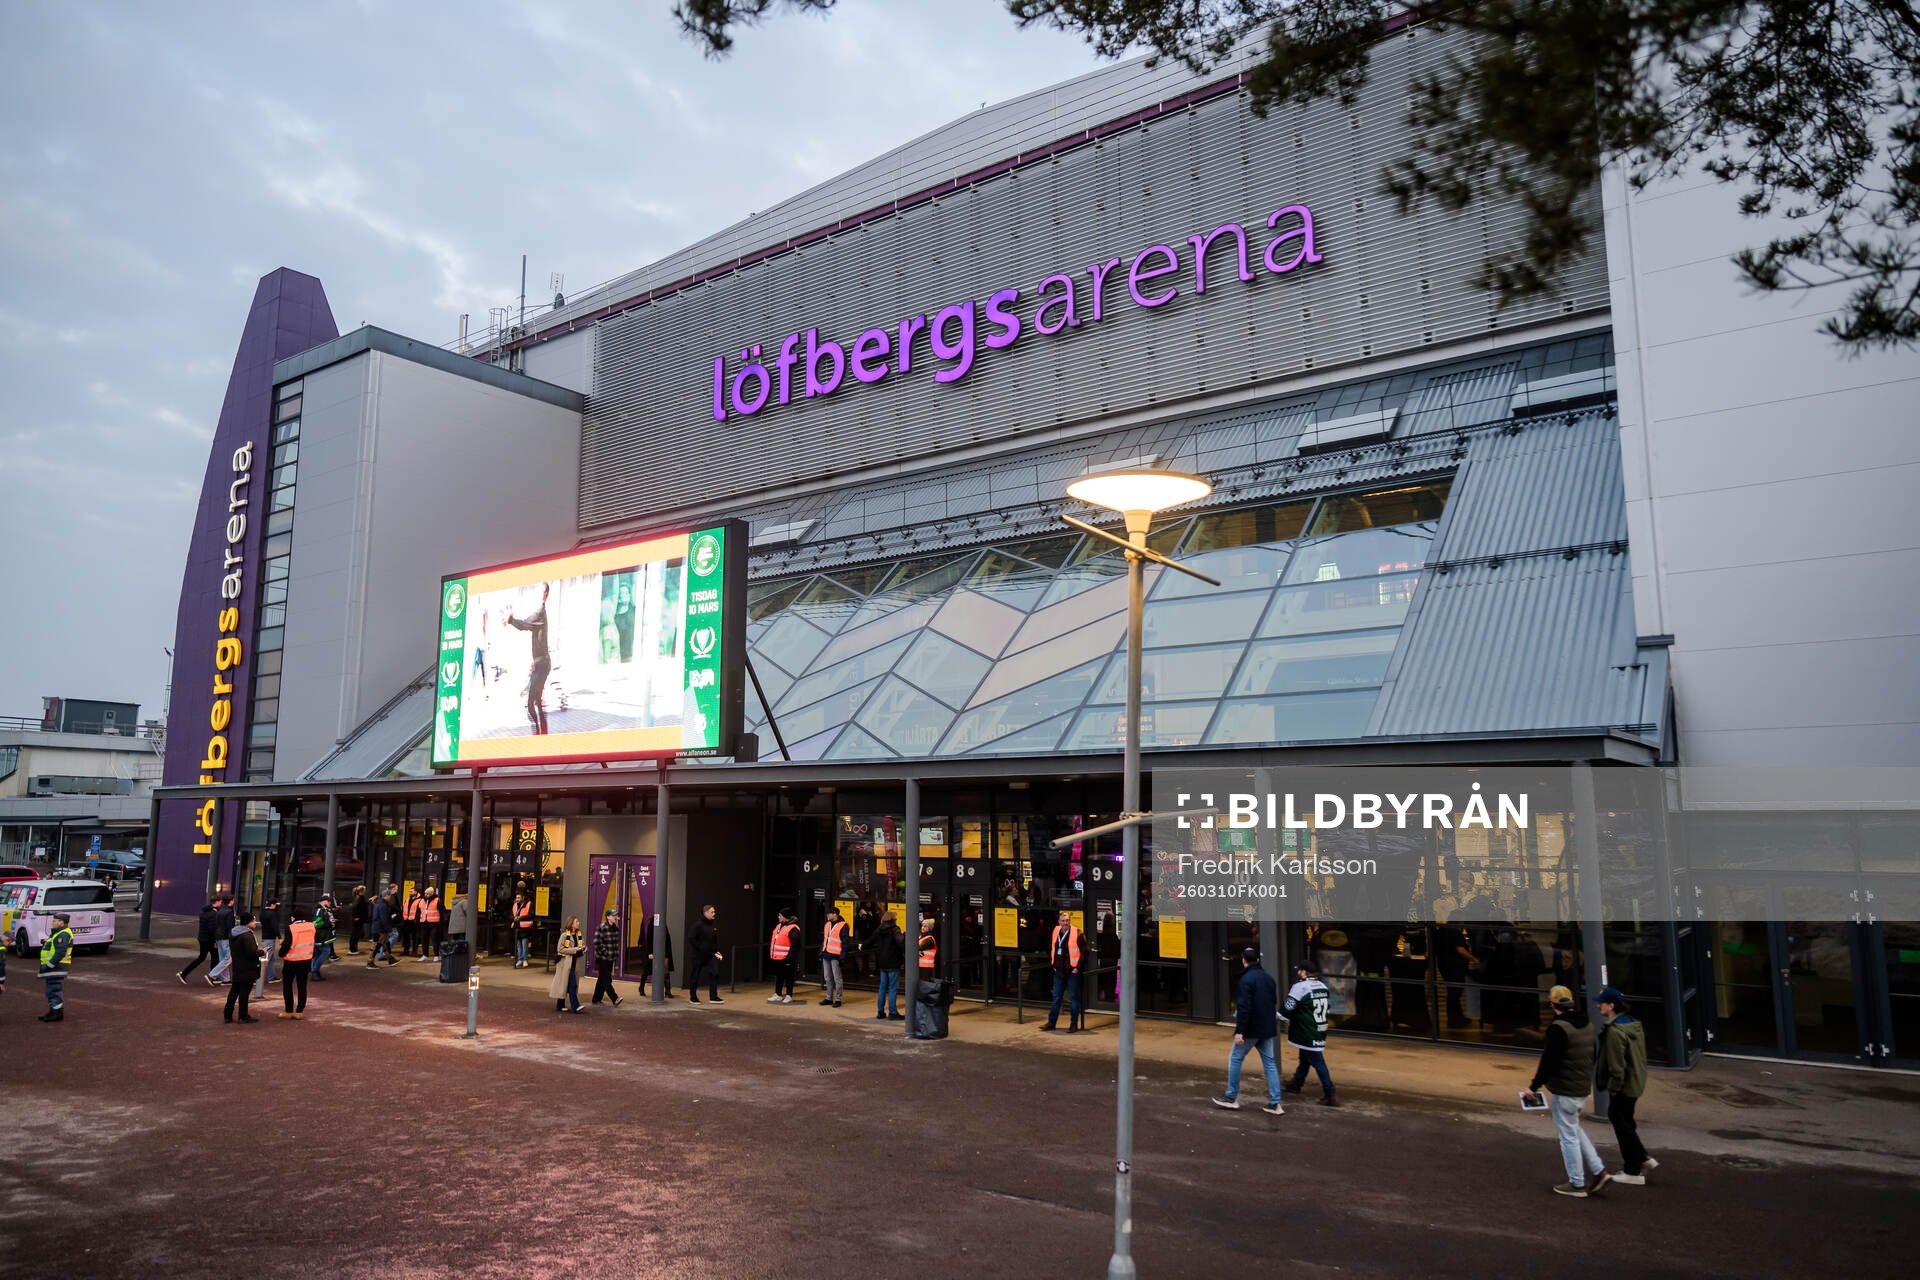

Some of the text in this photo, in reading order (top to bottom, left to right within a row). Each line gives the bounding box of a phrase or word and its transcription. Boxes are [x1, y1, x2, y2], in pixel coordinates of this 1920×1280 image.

[698, 601, 719, 614] MARS
[493, 854, 499, 864] 3
[516, 854, 522, 864] 4
[803, 860, 811, 873] 6
[956, 864, 965, 878] 8
[1092, 866, 1102, 881] 9
[1312, 997, 1329, 1023] 27
